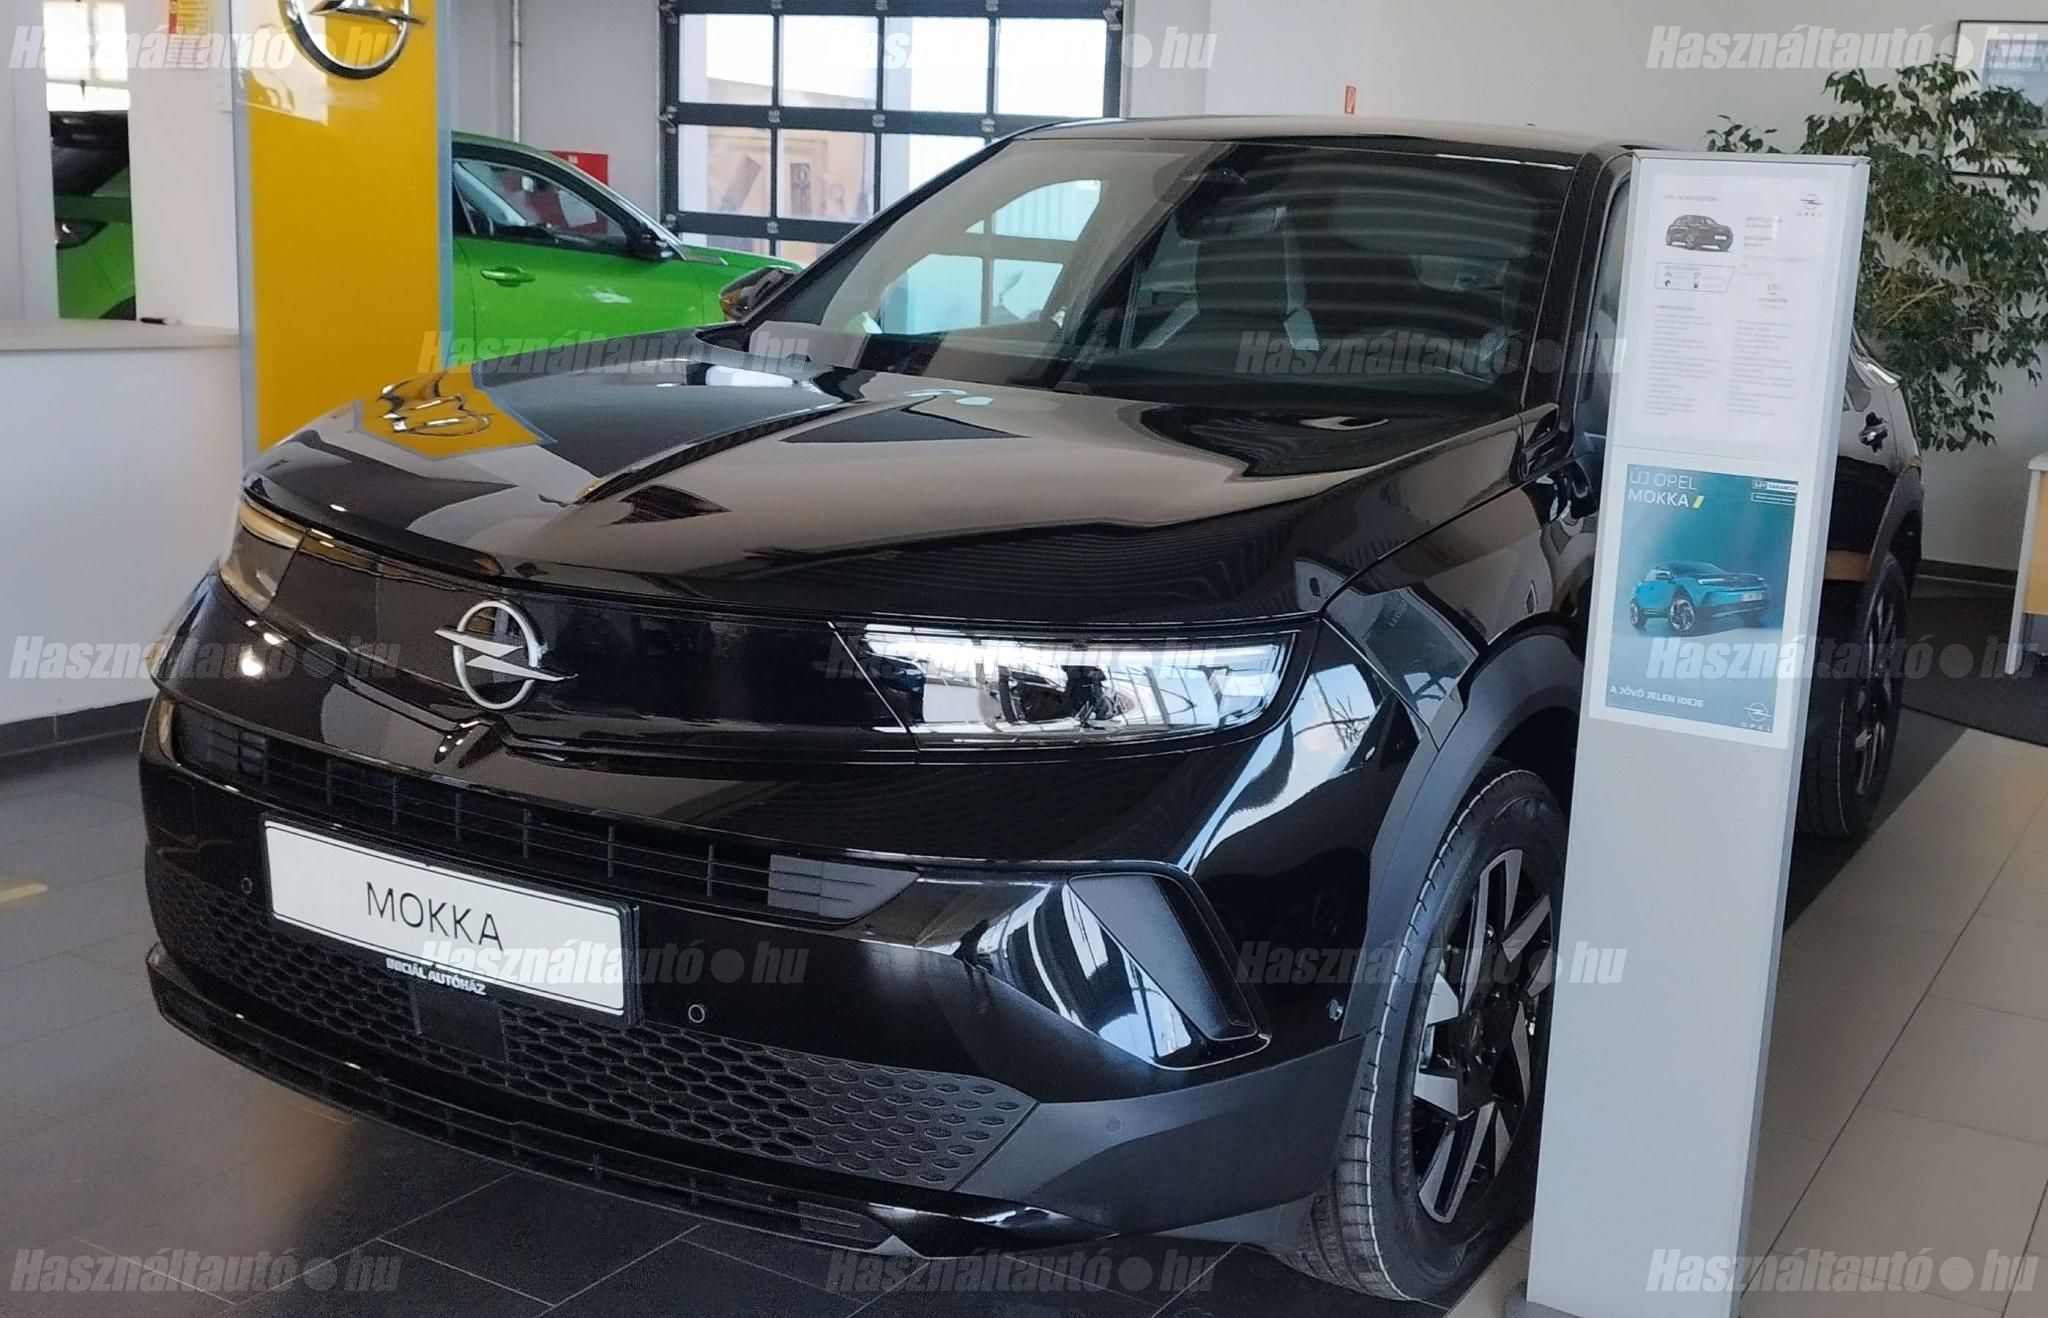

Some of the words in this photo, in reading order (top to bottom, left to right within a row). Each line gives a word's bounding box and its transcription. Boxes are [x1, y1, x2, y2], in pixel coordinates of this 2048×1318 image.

[1629, 467, 1649, 485] ÚJ
[1654, 472, 1698, 491] OPEL
[1627, 489, 1690, 508] MOKKA
[1609, 685, 1617, 694] A
[1646, 690, 1676, 703] JELEN
[366, 881, 504, 952] MOKKA
[428, 970, 487, 996] AUTÓHÁZ
